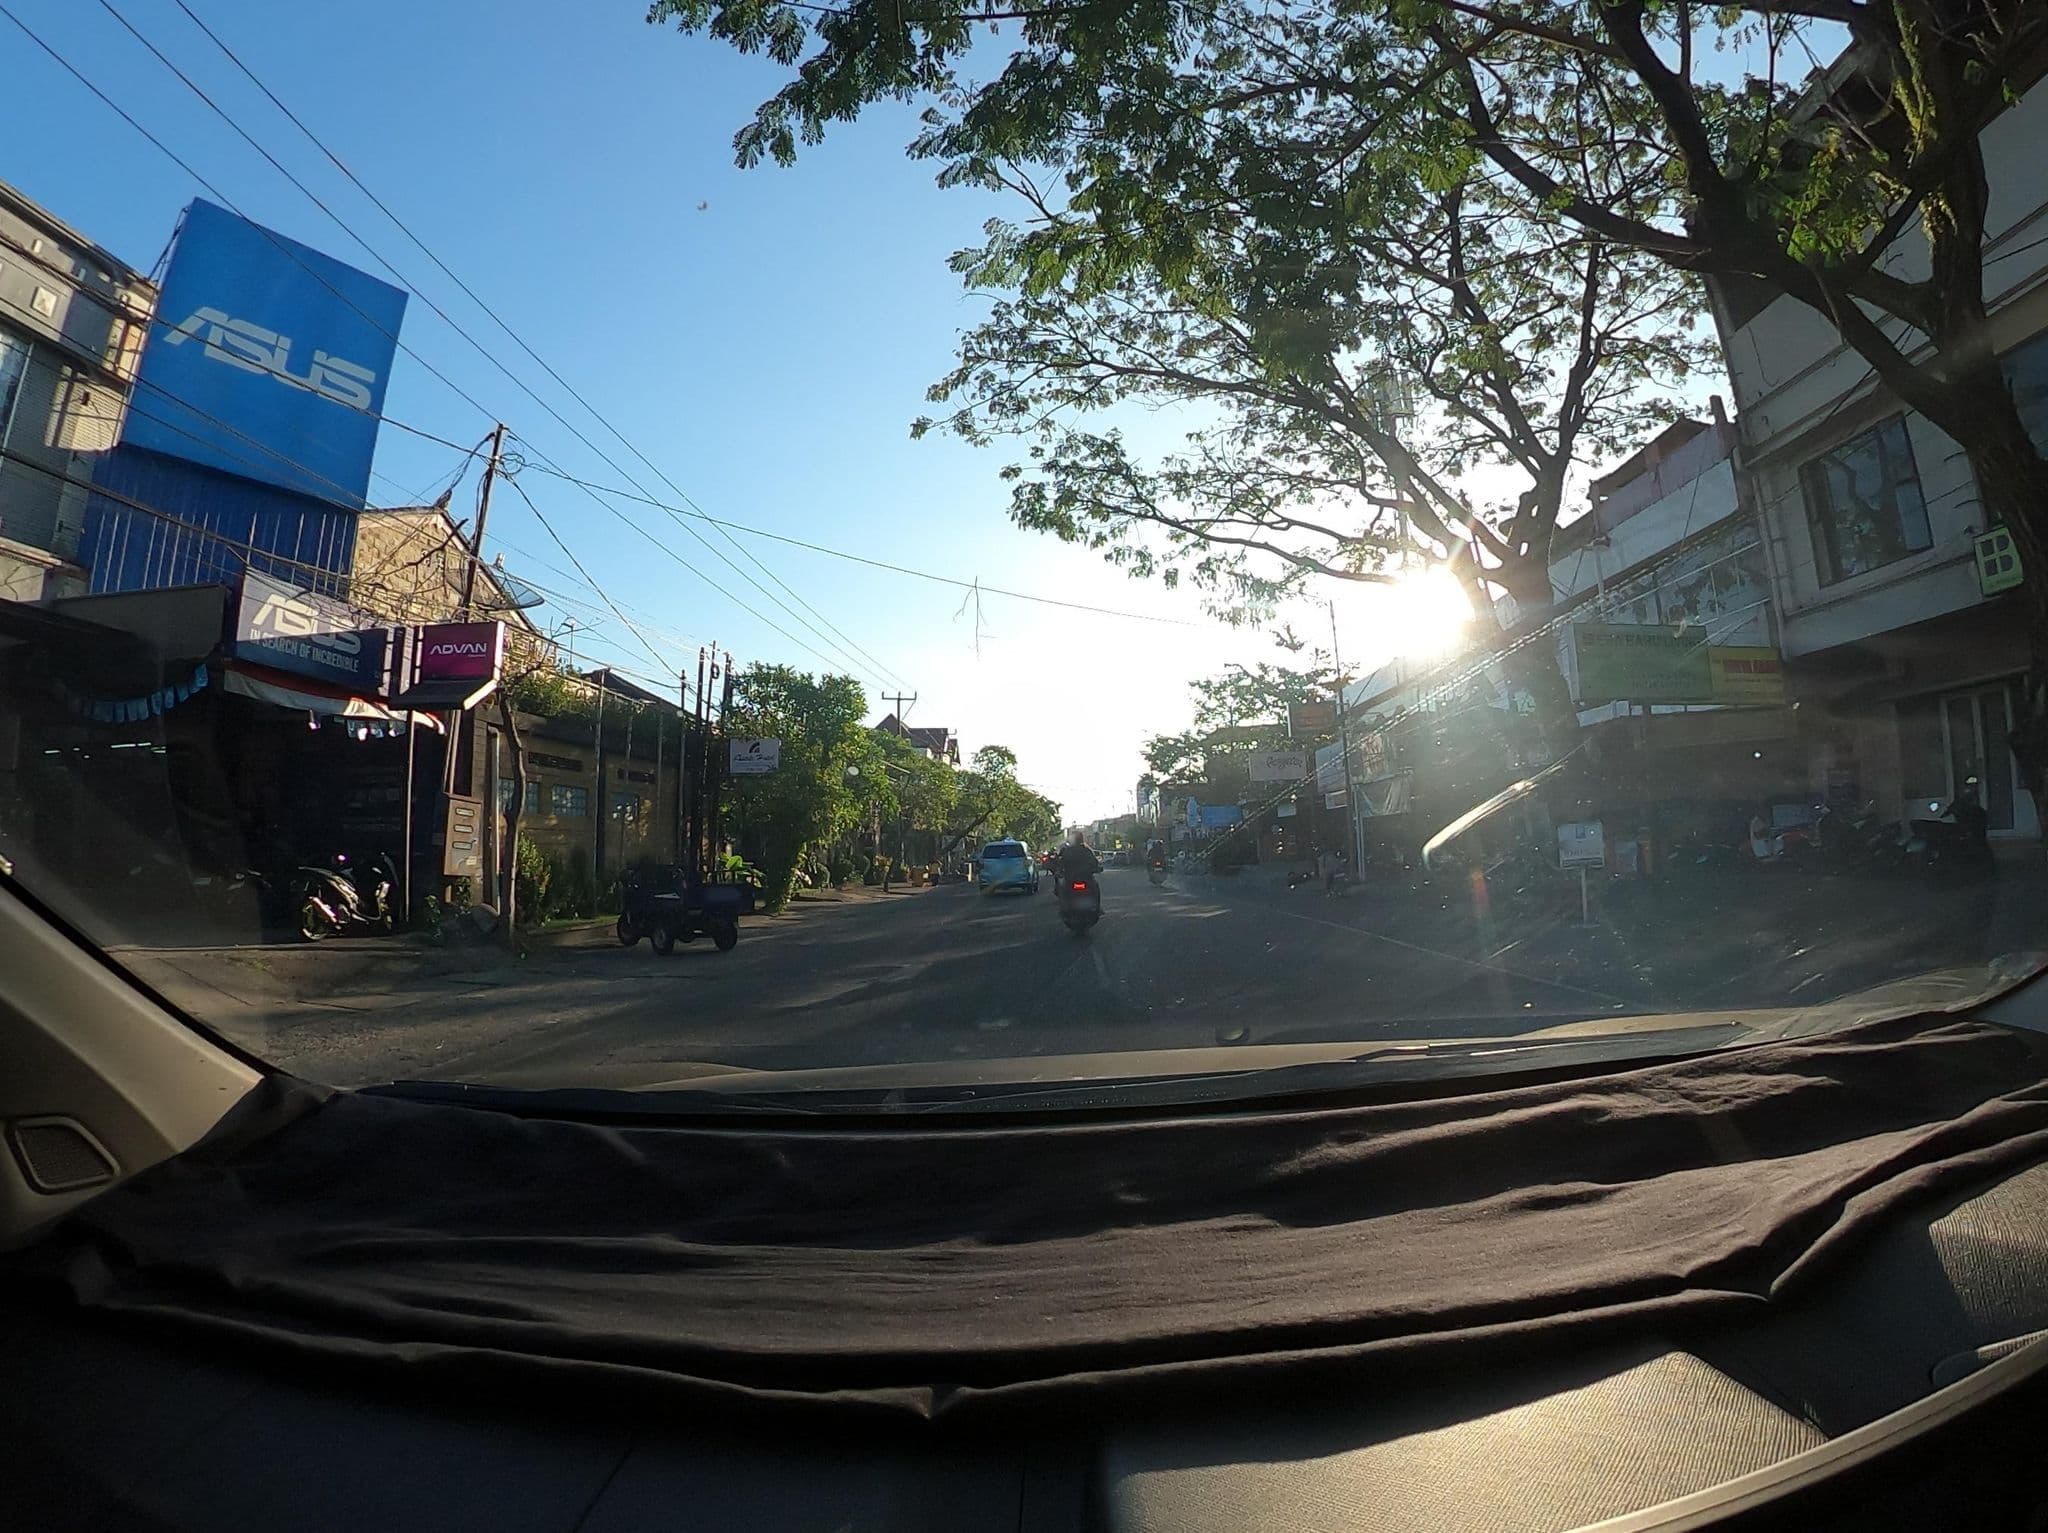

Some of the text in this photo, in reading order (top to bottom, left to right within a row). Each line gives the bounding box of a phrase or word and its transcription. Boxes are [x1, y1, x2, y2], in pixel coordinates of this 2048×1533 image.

[164, 306, 375, 410] ASUS
[253, 593, 361, 655] ASUS
[430, 642, 487, 655] ADVAN
[249, 629, 359, 673] IN SEARCH OF INCREDIBLE
